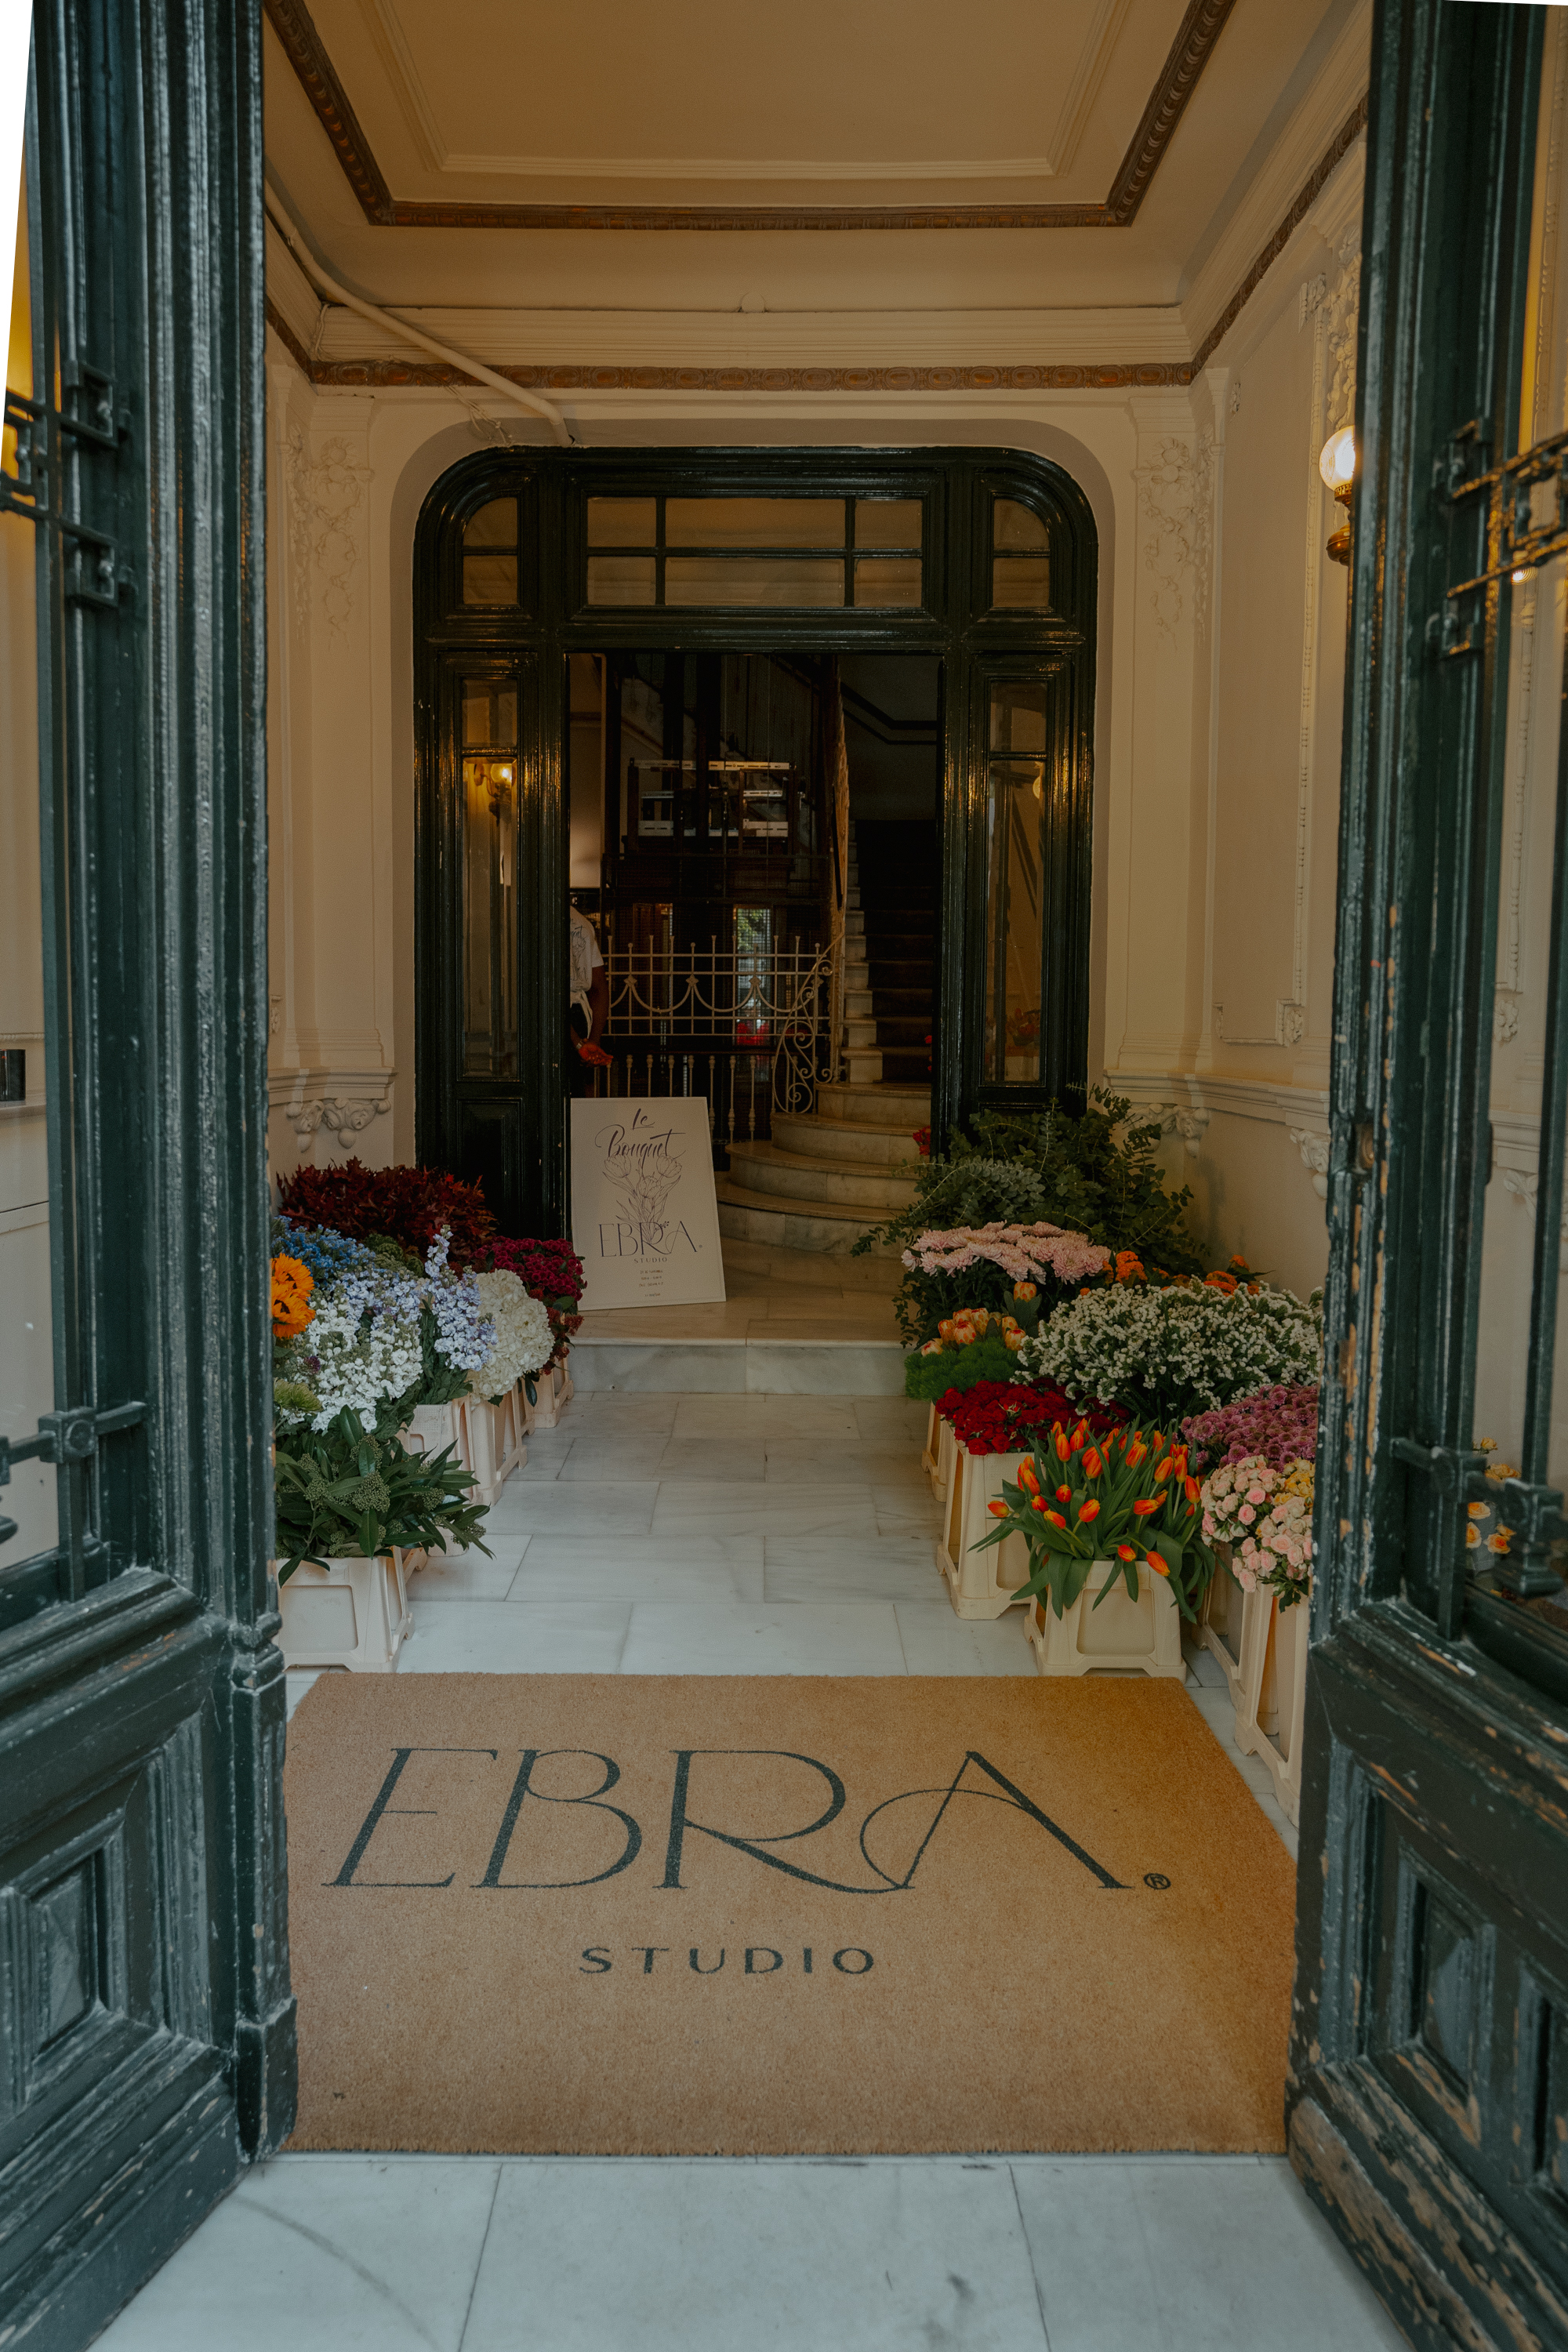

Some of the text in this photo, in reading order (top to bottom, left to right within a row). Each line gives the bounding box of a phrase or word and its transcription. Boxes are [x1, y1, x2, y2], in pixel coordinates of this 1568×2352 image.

[632, 1107, 655, 1129] Le
[594, 1123, 687, 1171] Bouquet
[579, 1946, 875, 1974] STUDIO
